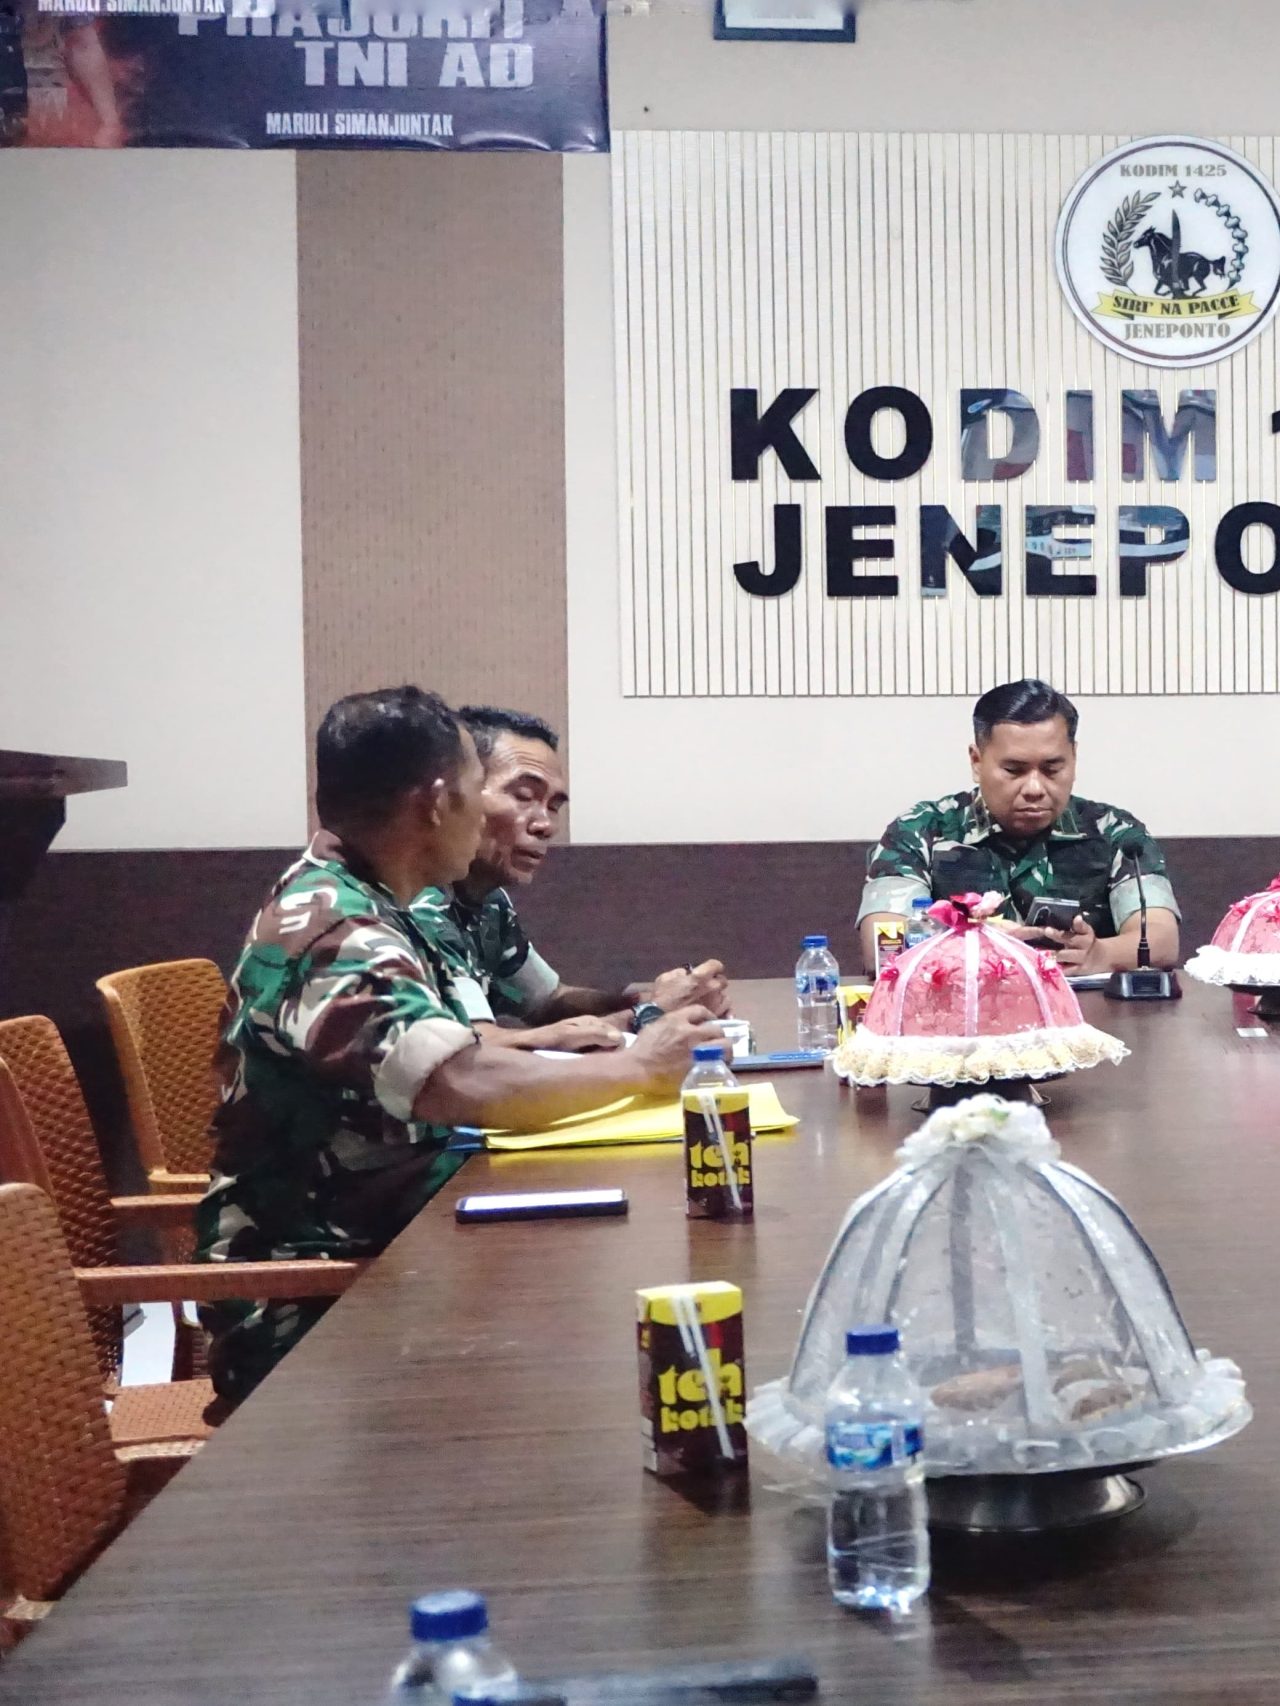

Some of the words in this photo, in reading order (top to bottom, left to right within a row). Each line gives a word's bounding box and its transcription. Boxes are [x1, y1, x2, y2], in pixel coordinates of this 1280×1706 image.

[295, 41, 407, 87] TNI
[439, 42, 535, 88] AD
[266, 112, 329, 136] MARULI
[335, 112, 453, 136] SIMANJUNTAK
[1120, 164, 1178, 177] KODIM
[1185, 164, 1227, 177] 1425
[1161, 302, 1182, 315] NA
[1188, 294, 1240, 314] PACCE
[1124, 322, 1231, 340] JENEPONTO
[730, 386, 1217, 482] KODIM
